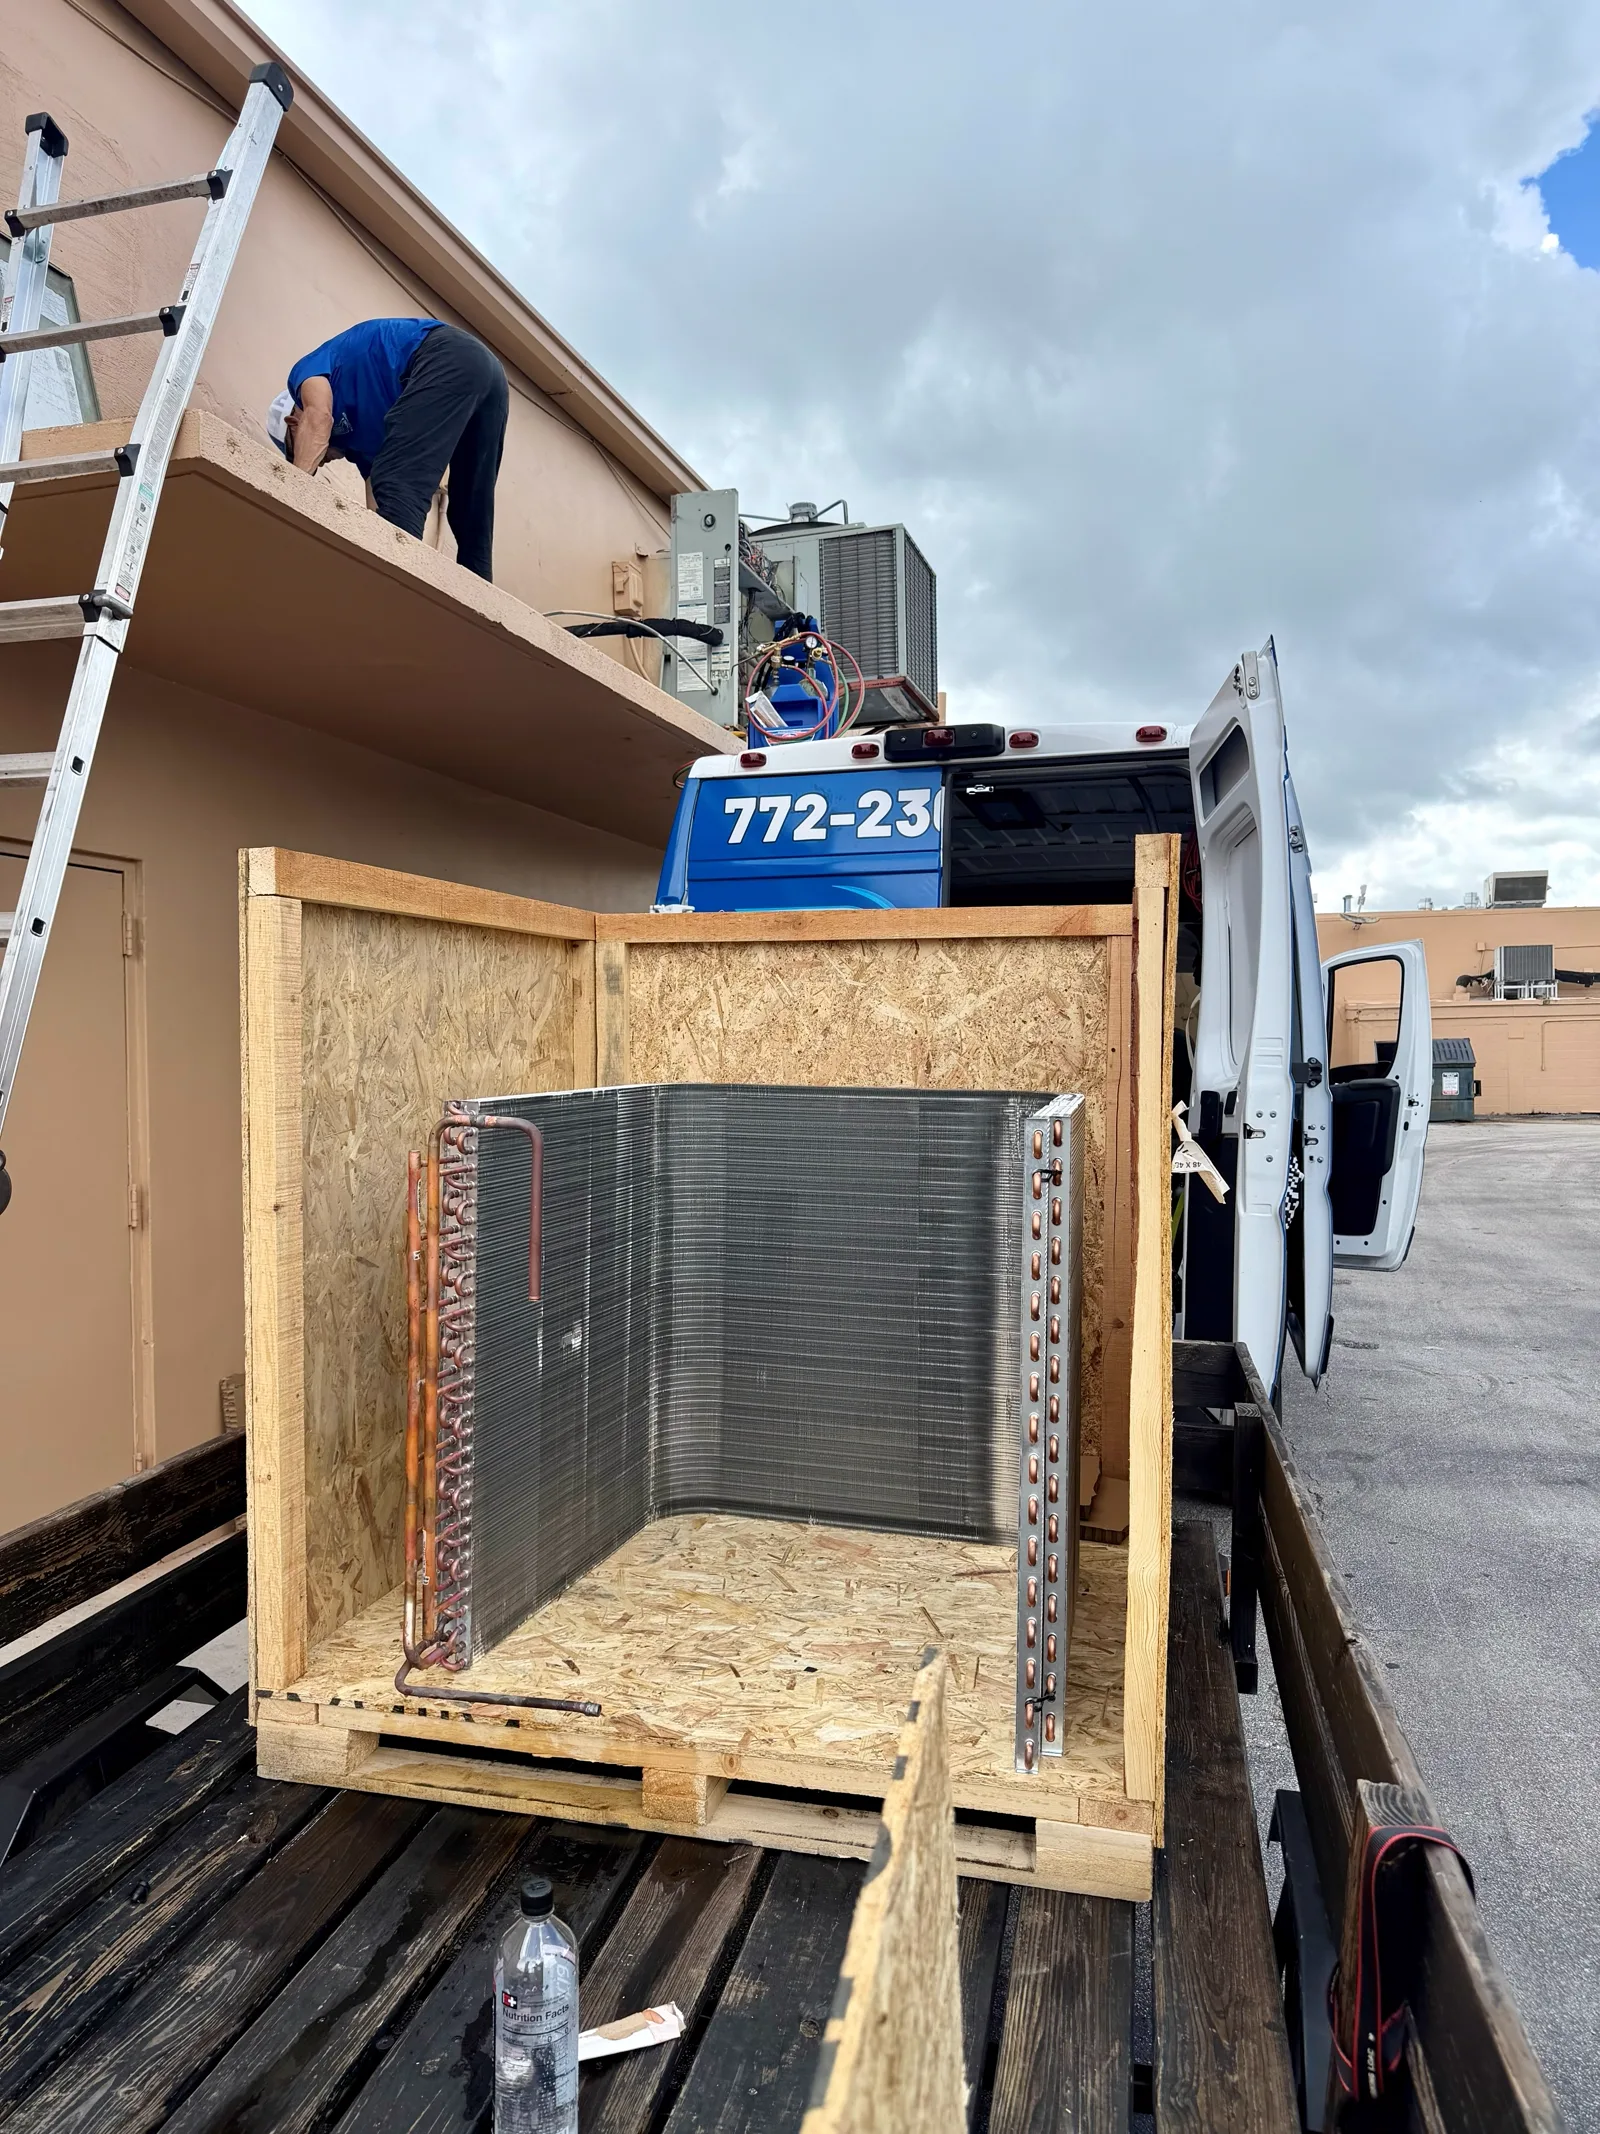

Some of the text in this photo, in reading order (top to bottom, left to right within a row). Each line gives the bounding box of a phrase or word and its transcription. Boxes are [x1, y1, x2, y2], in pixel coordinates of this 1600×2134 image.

[725, 787, 941, 844] 772-23
[502, 2004, 570, 2022] Nutrition Facts
